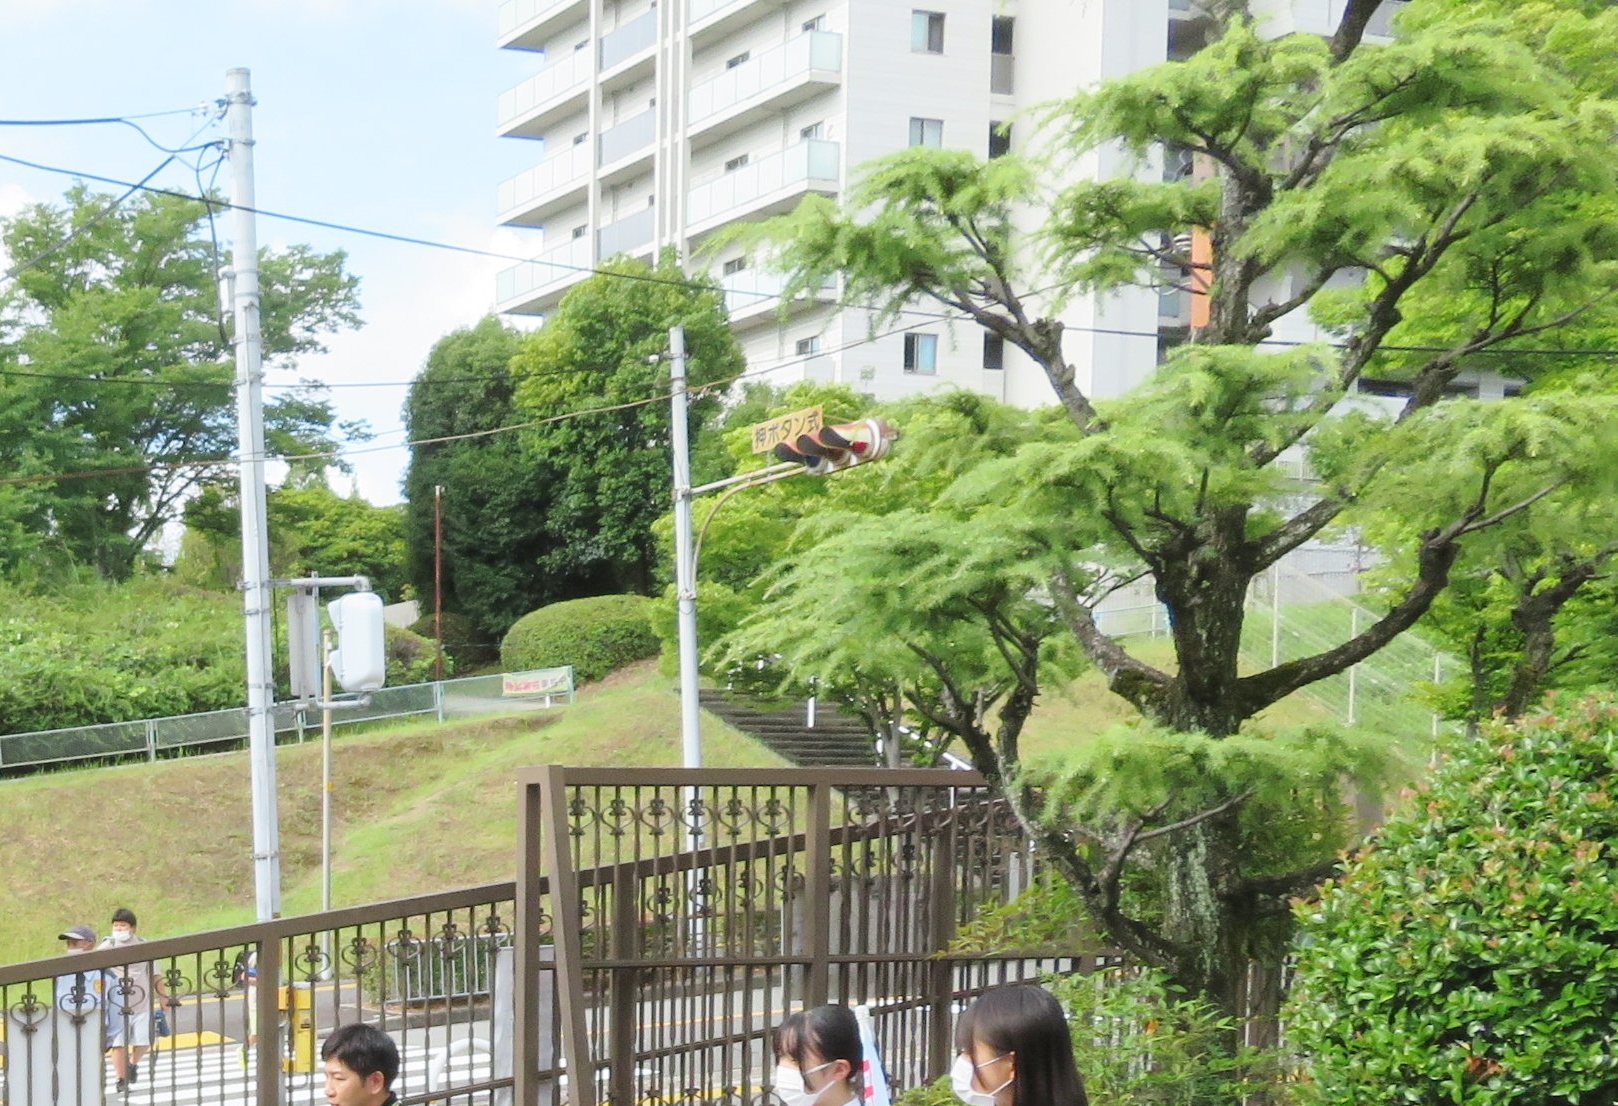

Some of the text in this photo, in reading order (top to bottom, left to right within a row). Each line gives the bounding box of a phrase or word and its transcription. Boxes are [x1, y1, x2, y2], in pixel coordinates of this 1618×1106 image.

[755, 410, 820, 449] 押ボタン式
